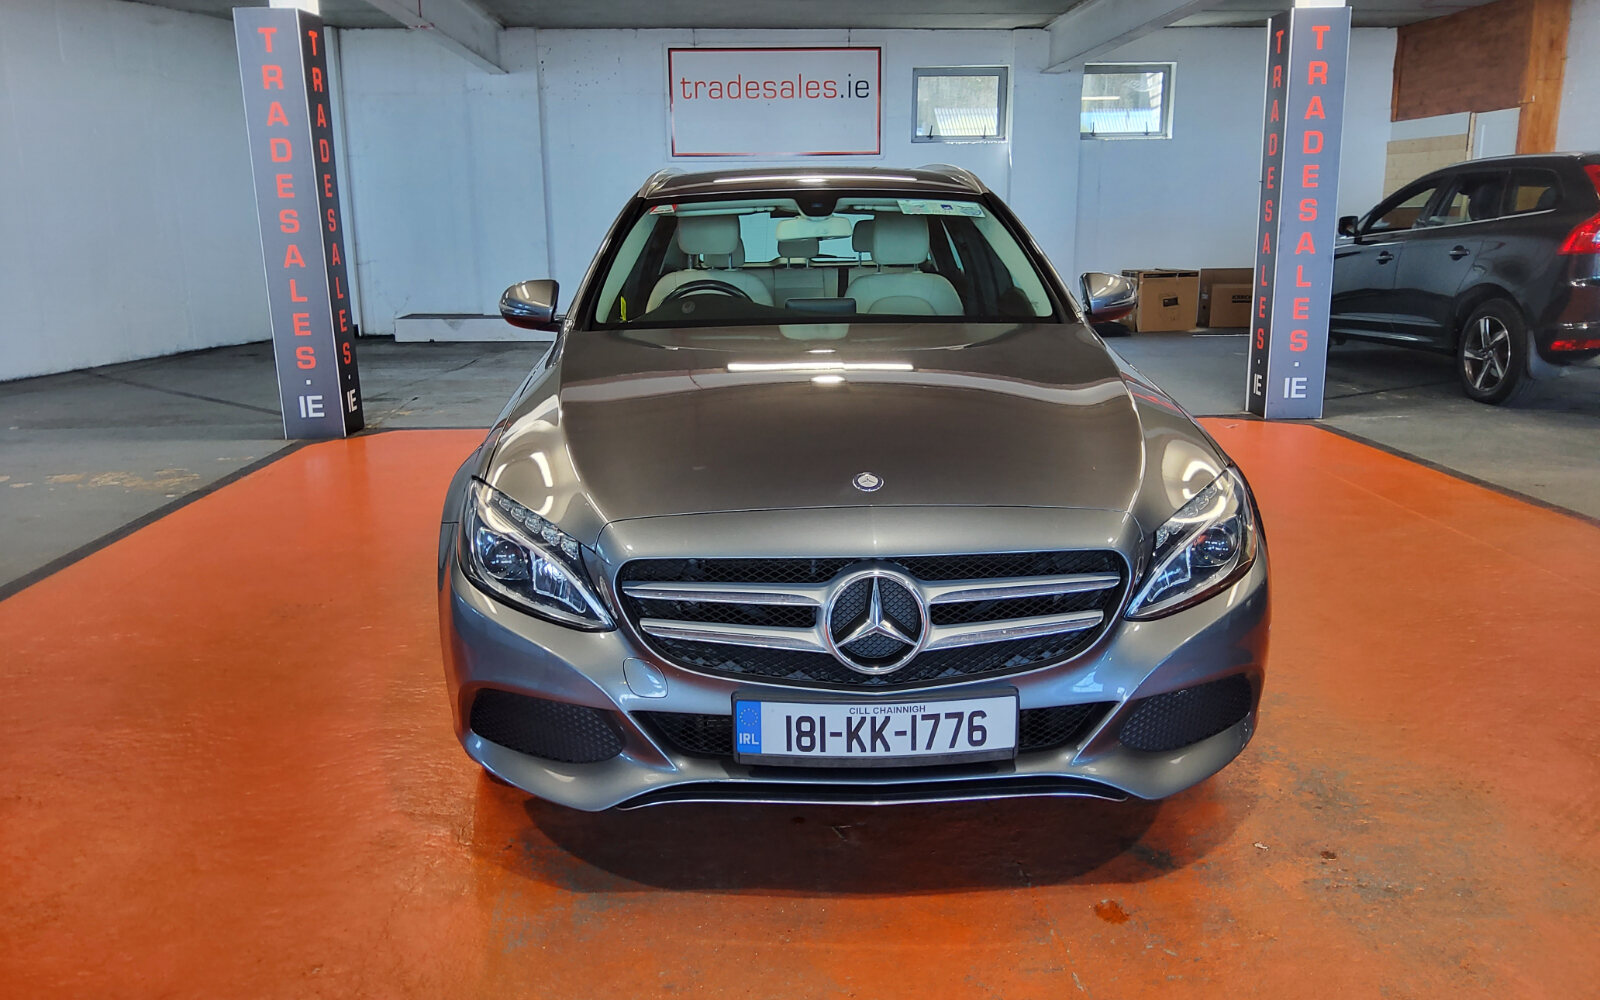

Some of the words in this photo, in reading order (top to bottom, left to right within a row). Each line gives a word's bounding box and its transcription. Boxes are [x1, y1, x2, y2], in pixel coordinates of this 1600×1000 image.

[680, 73, 870, 99] tradesales.ie
[849, 706, 871, 715] CILL
[872, 705, 926, 715] CHAINNIGH
[739, 732, 760, 745] IRL
[785, 710, 988, 753] 181-KK-1776
